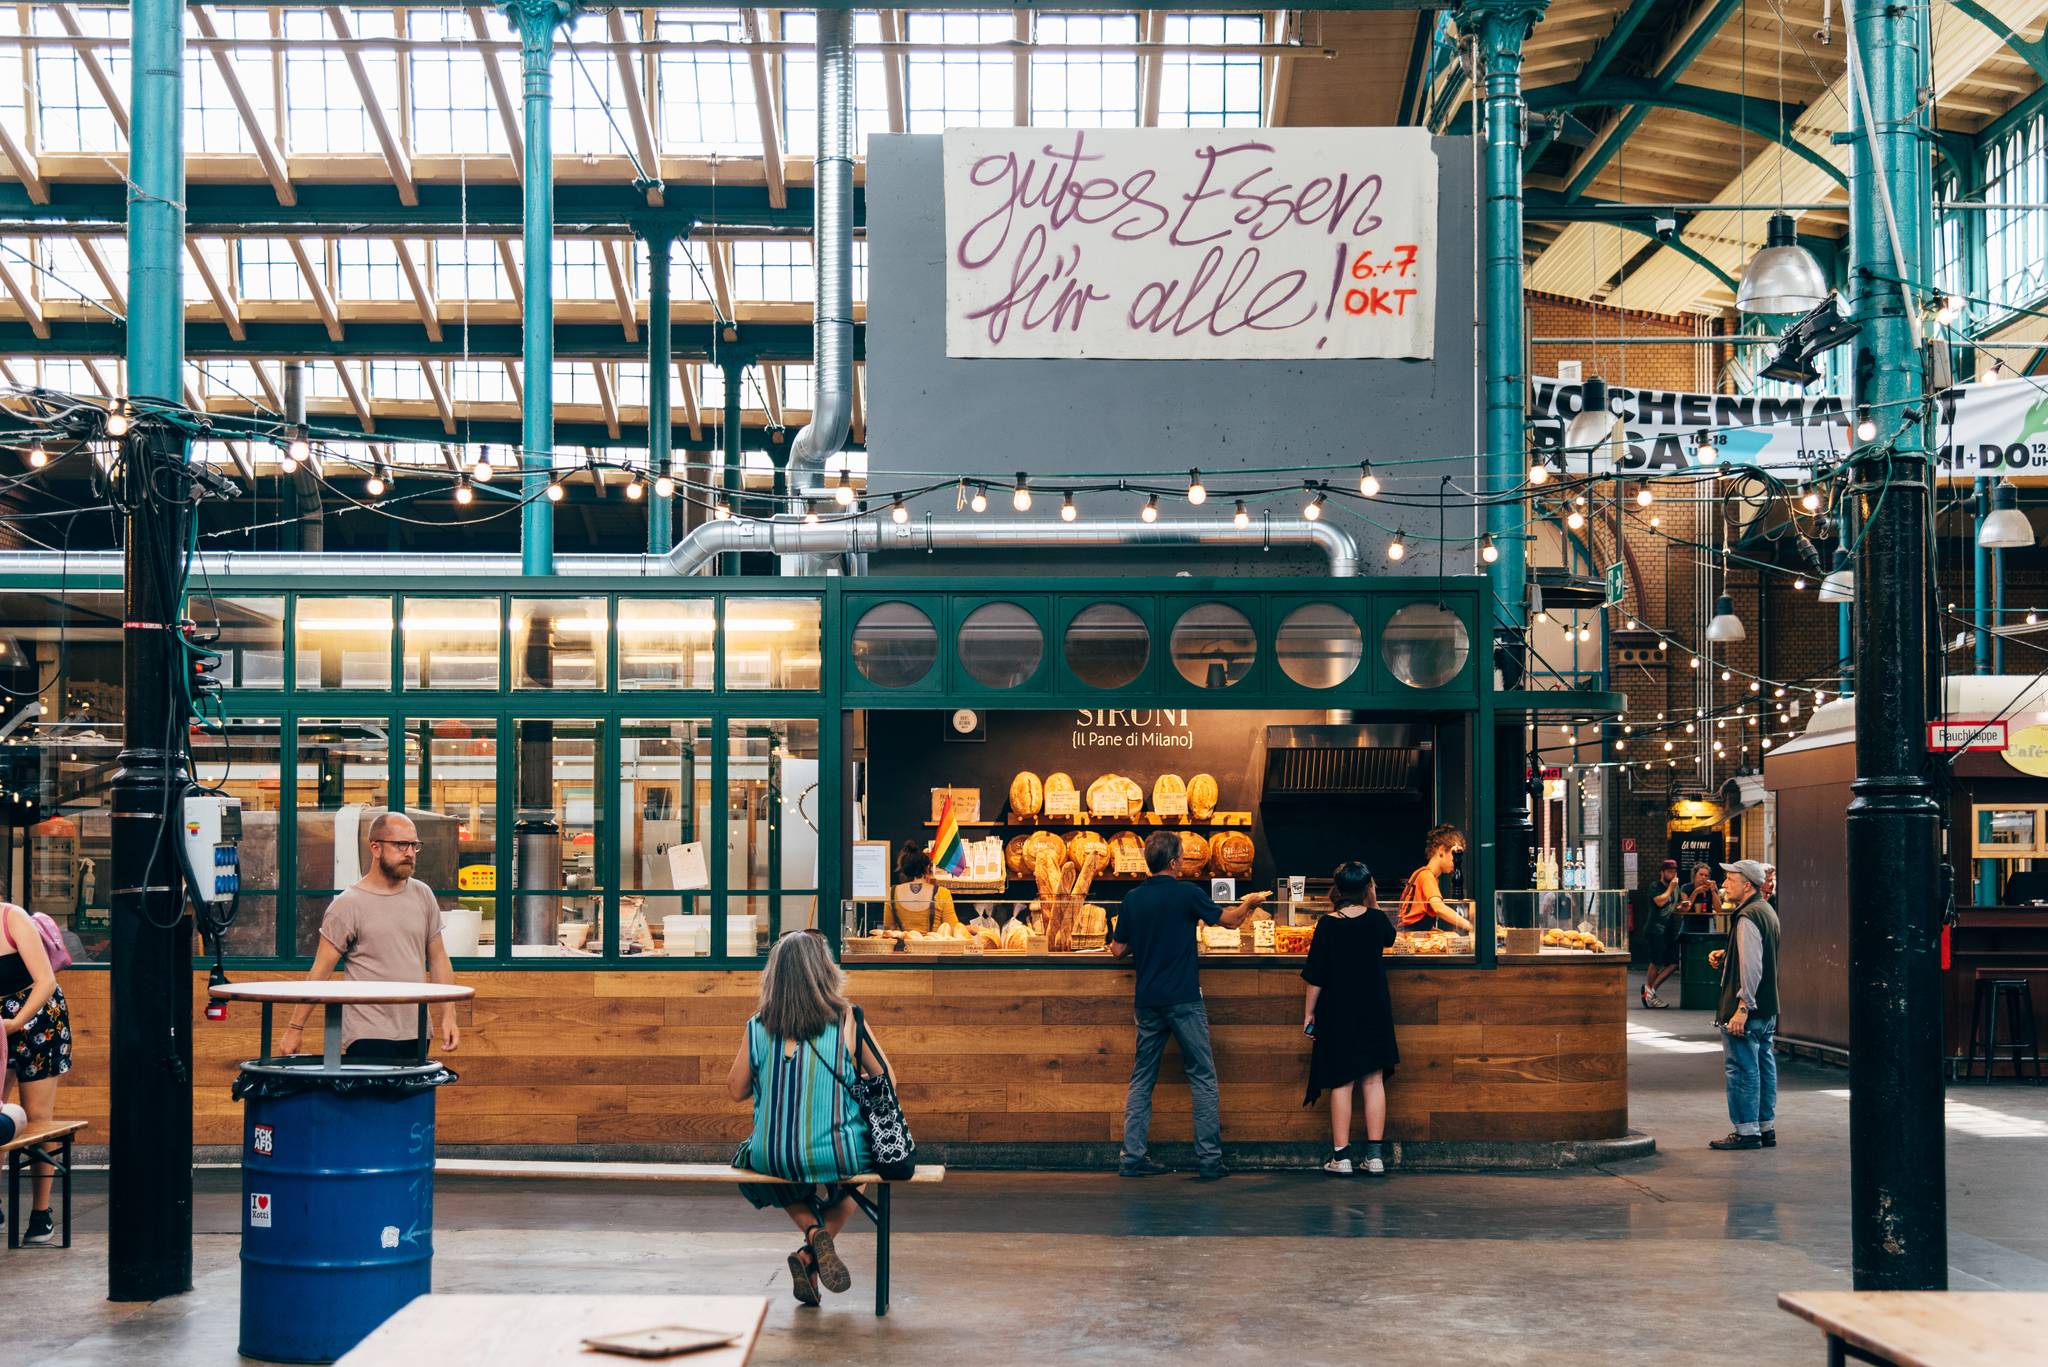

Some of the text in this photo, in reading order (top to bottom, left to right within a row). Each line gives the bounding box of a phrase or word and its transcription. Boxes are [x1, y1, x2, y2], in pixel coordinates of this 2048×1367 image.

[958, 131, 1383, 270] gutes Essen
[963, 224, 1347, 350] für alle!
[1343, 287, 1418, 317] OKT
[1089, 732, 1122, 746] Pane
[1126, 732, 1138, 746] di
[1939, 728, 1998, 744] Rauchklappe
[254, 1127, 273, 1142] FCK
[254, 1138, 273, 1152] AFD
[252, 1194, 258, 1209] I
[252, 1210, 269, 1220] Kotti
